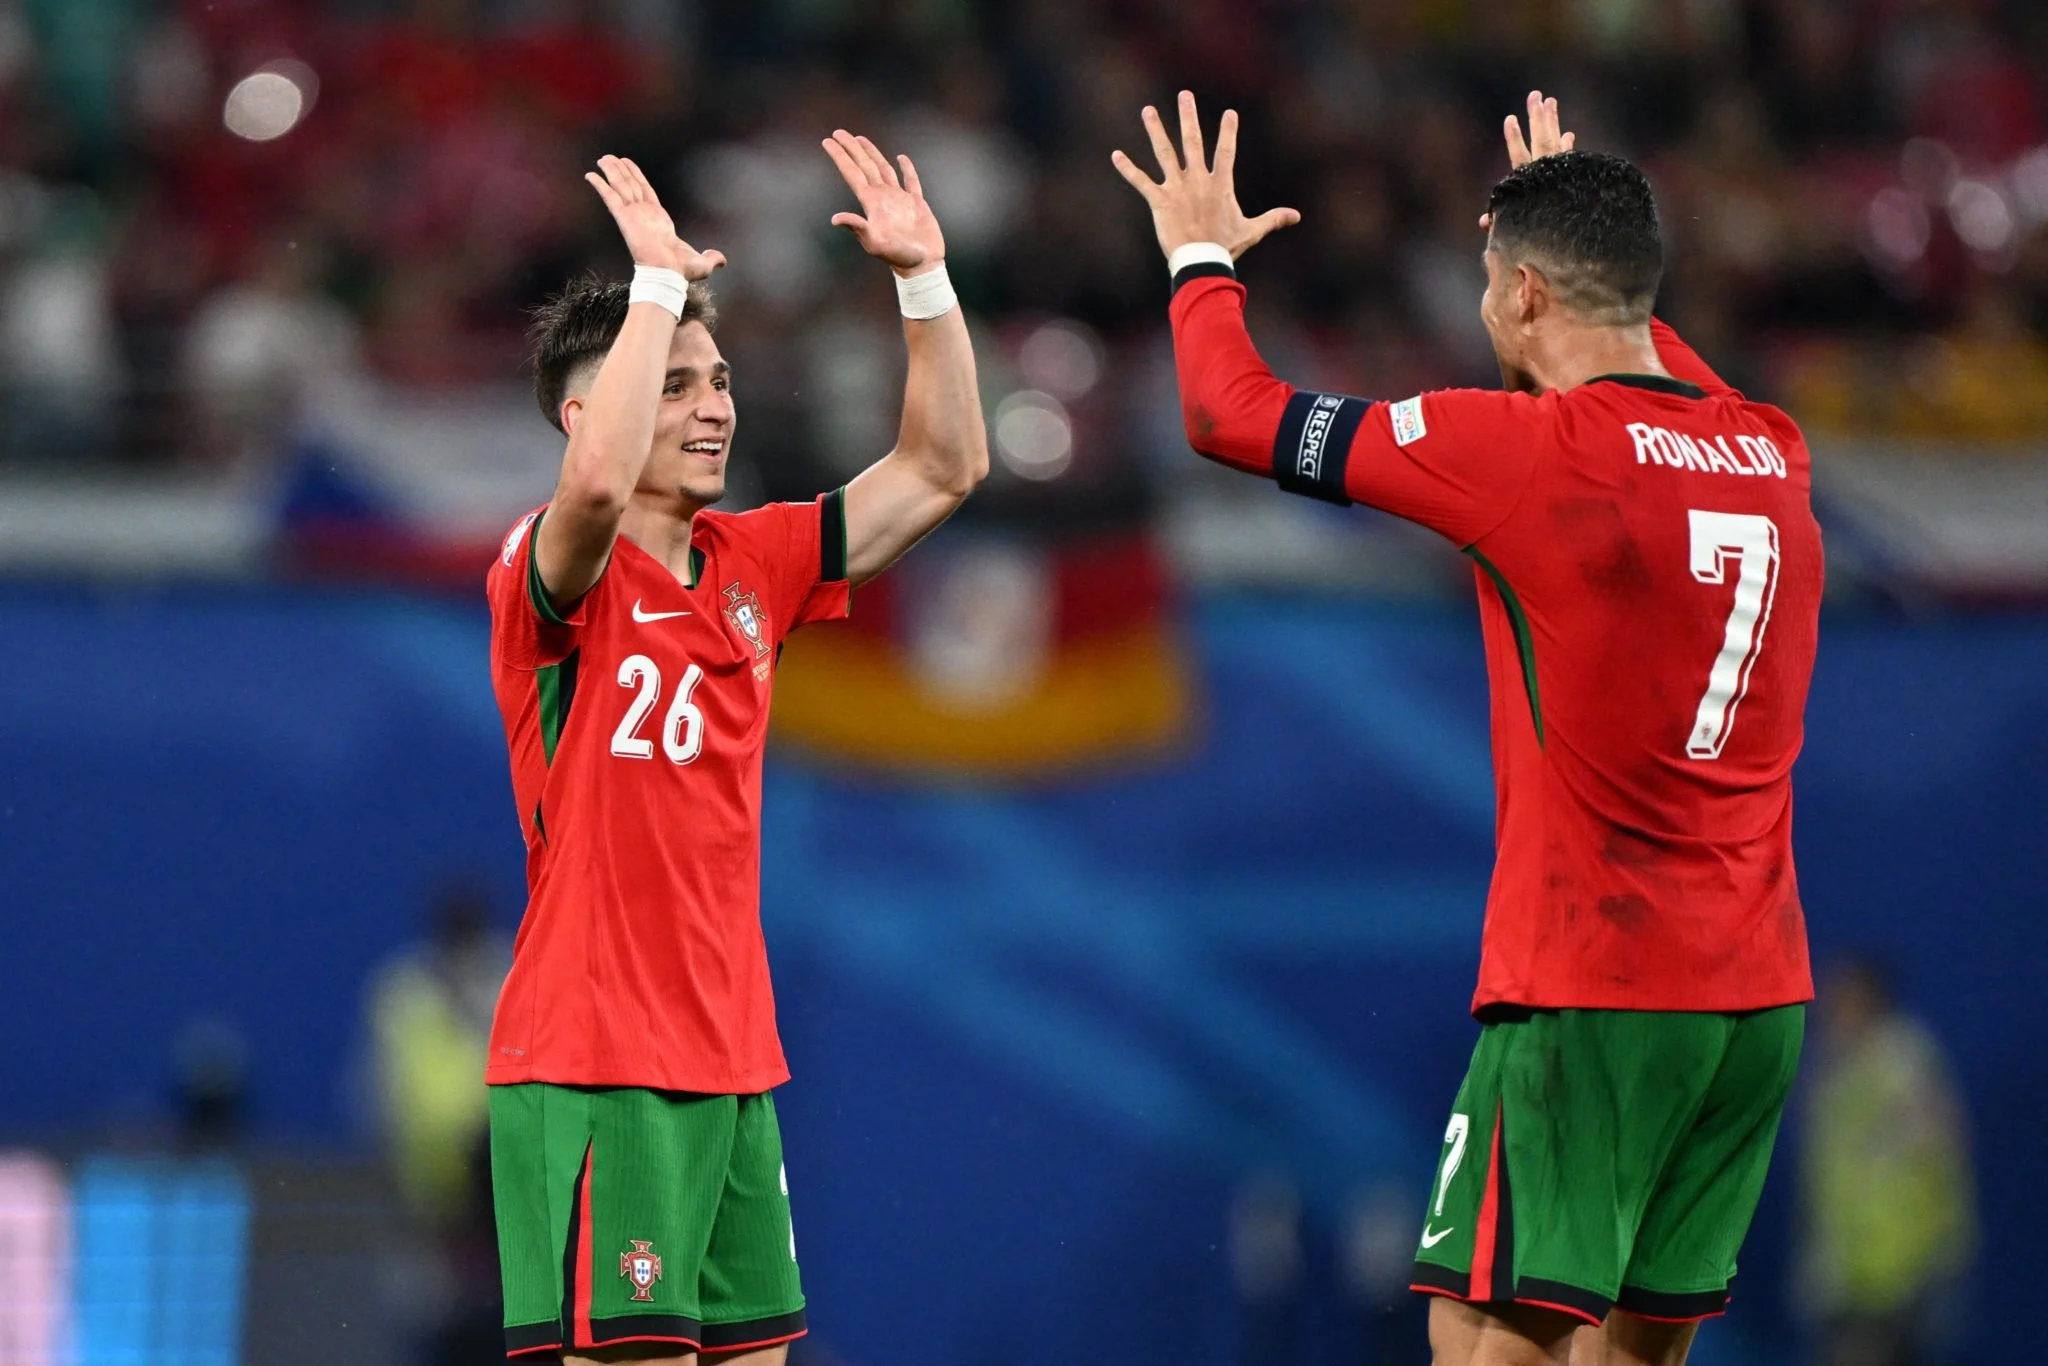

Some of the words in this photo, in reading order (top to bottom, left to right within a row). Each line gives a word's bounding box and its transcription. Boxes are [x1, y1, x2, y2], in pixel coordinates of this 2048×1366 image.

[1302, 409, 1330, 479] RESPECT
[1626, 422, 1787, 479] RONALDO
[1685, 508, 1781, 760] 7
[611, 654, 705, 766] 26
[1434, 1113, 1469, 1217] 7
